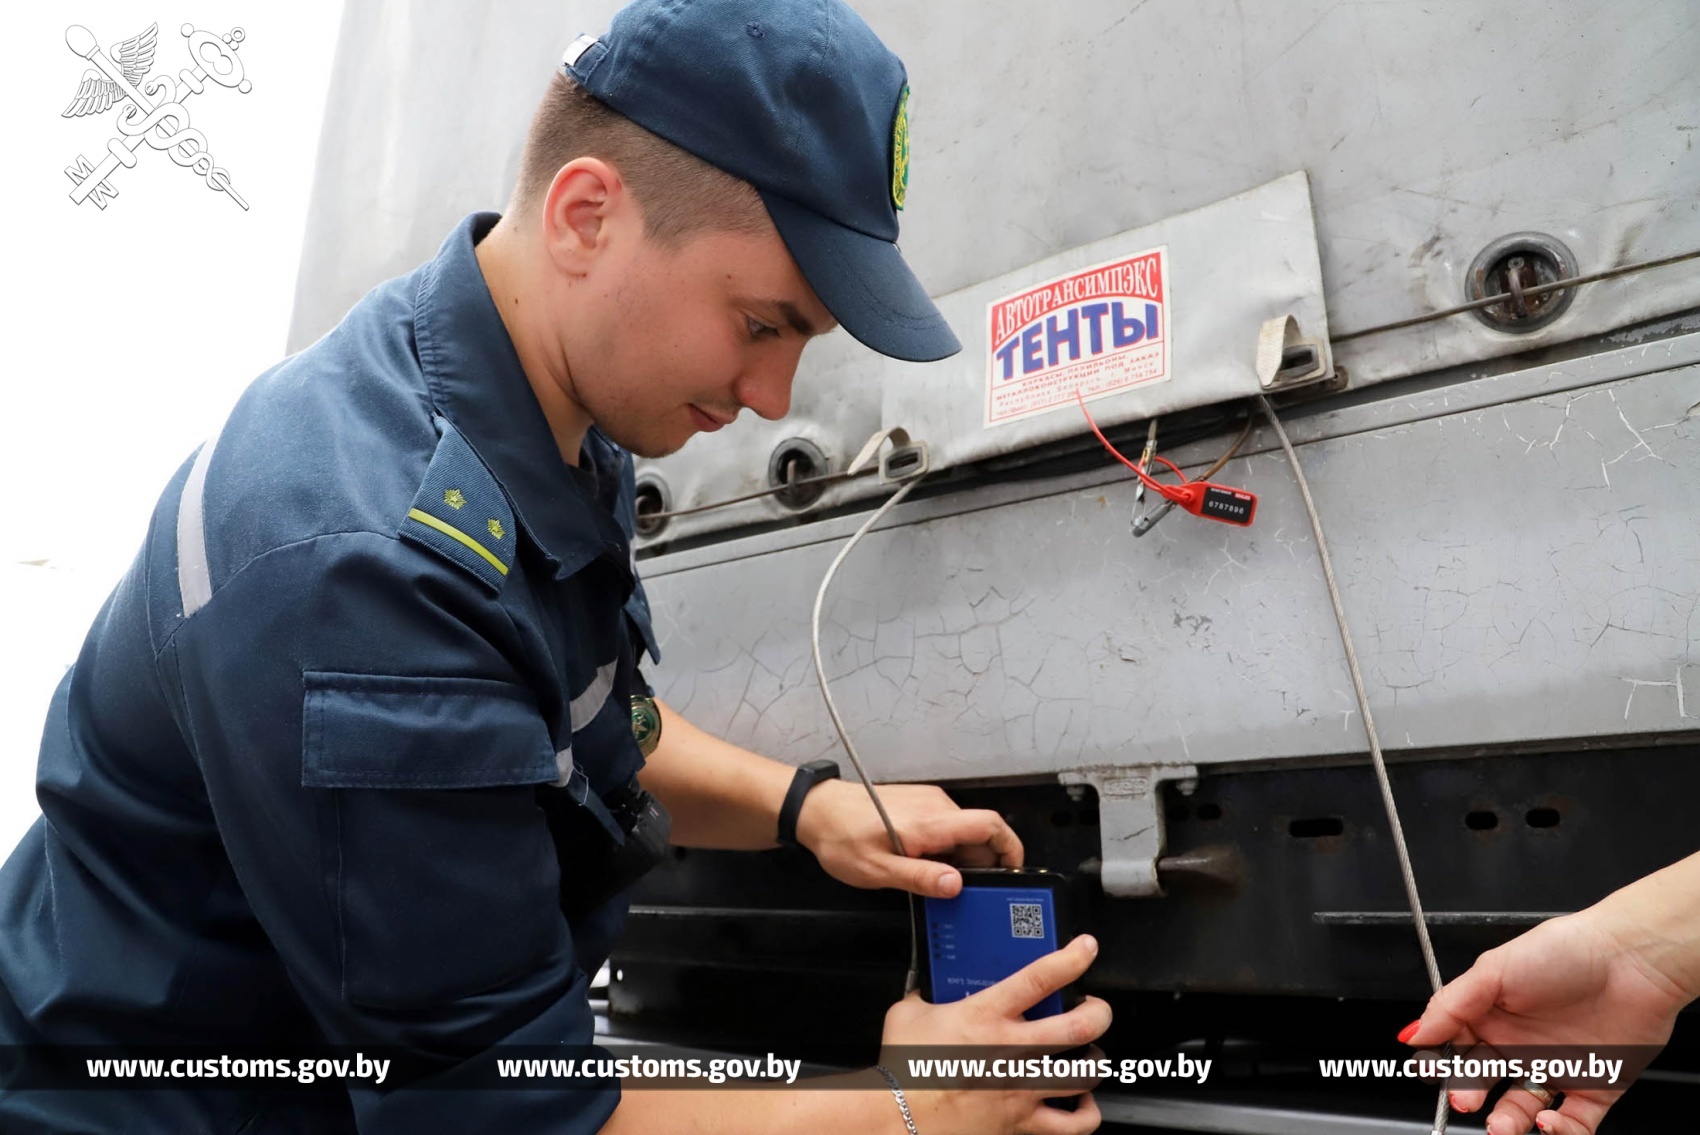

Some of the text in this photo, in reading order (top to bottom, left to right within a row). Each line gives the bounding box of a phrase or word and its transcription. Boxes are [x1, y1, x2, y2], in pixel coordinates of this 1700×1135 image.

[995, 257, 1159, 345] АВТОТРАНСИМПЭКС
[996, 301, 1159, 380] ТЕНТЫ
[1104, 361, 1125, 371] ПОД
[1129, 351, 1159, 364] ЗАКАЗ
